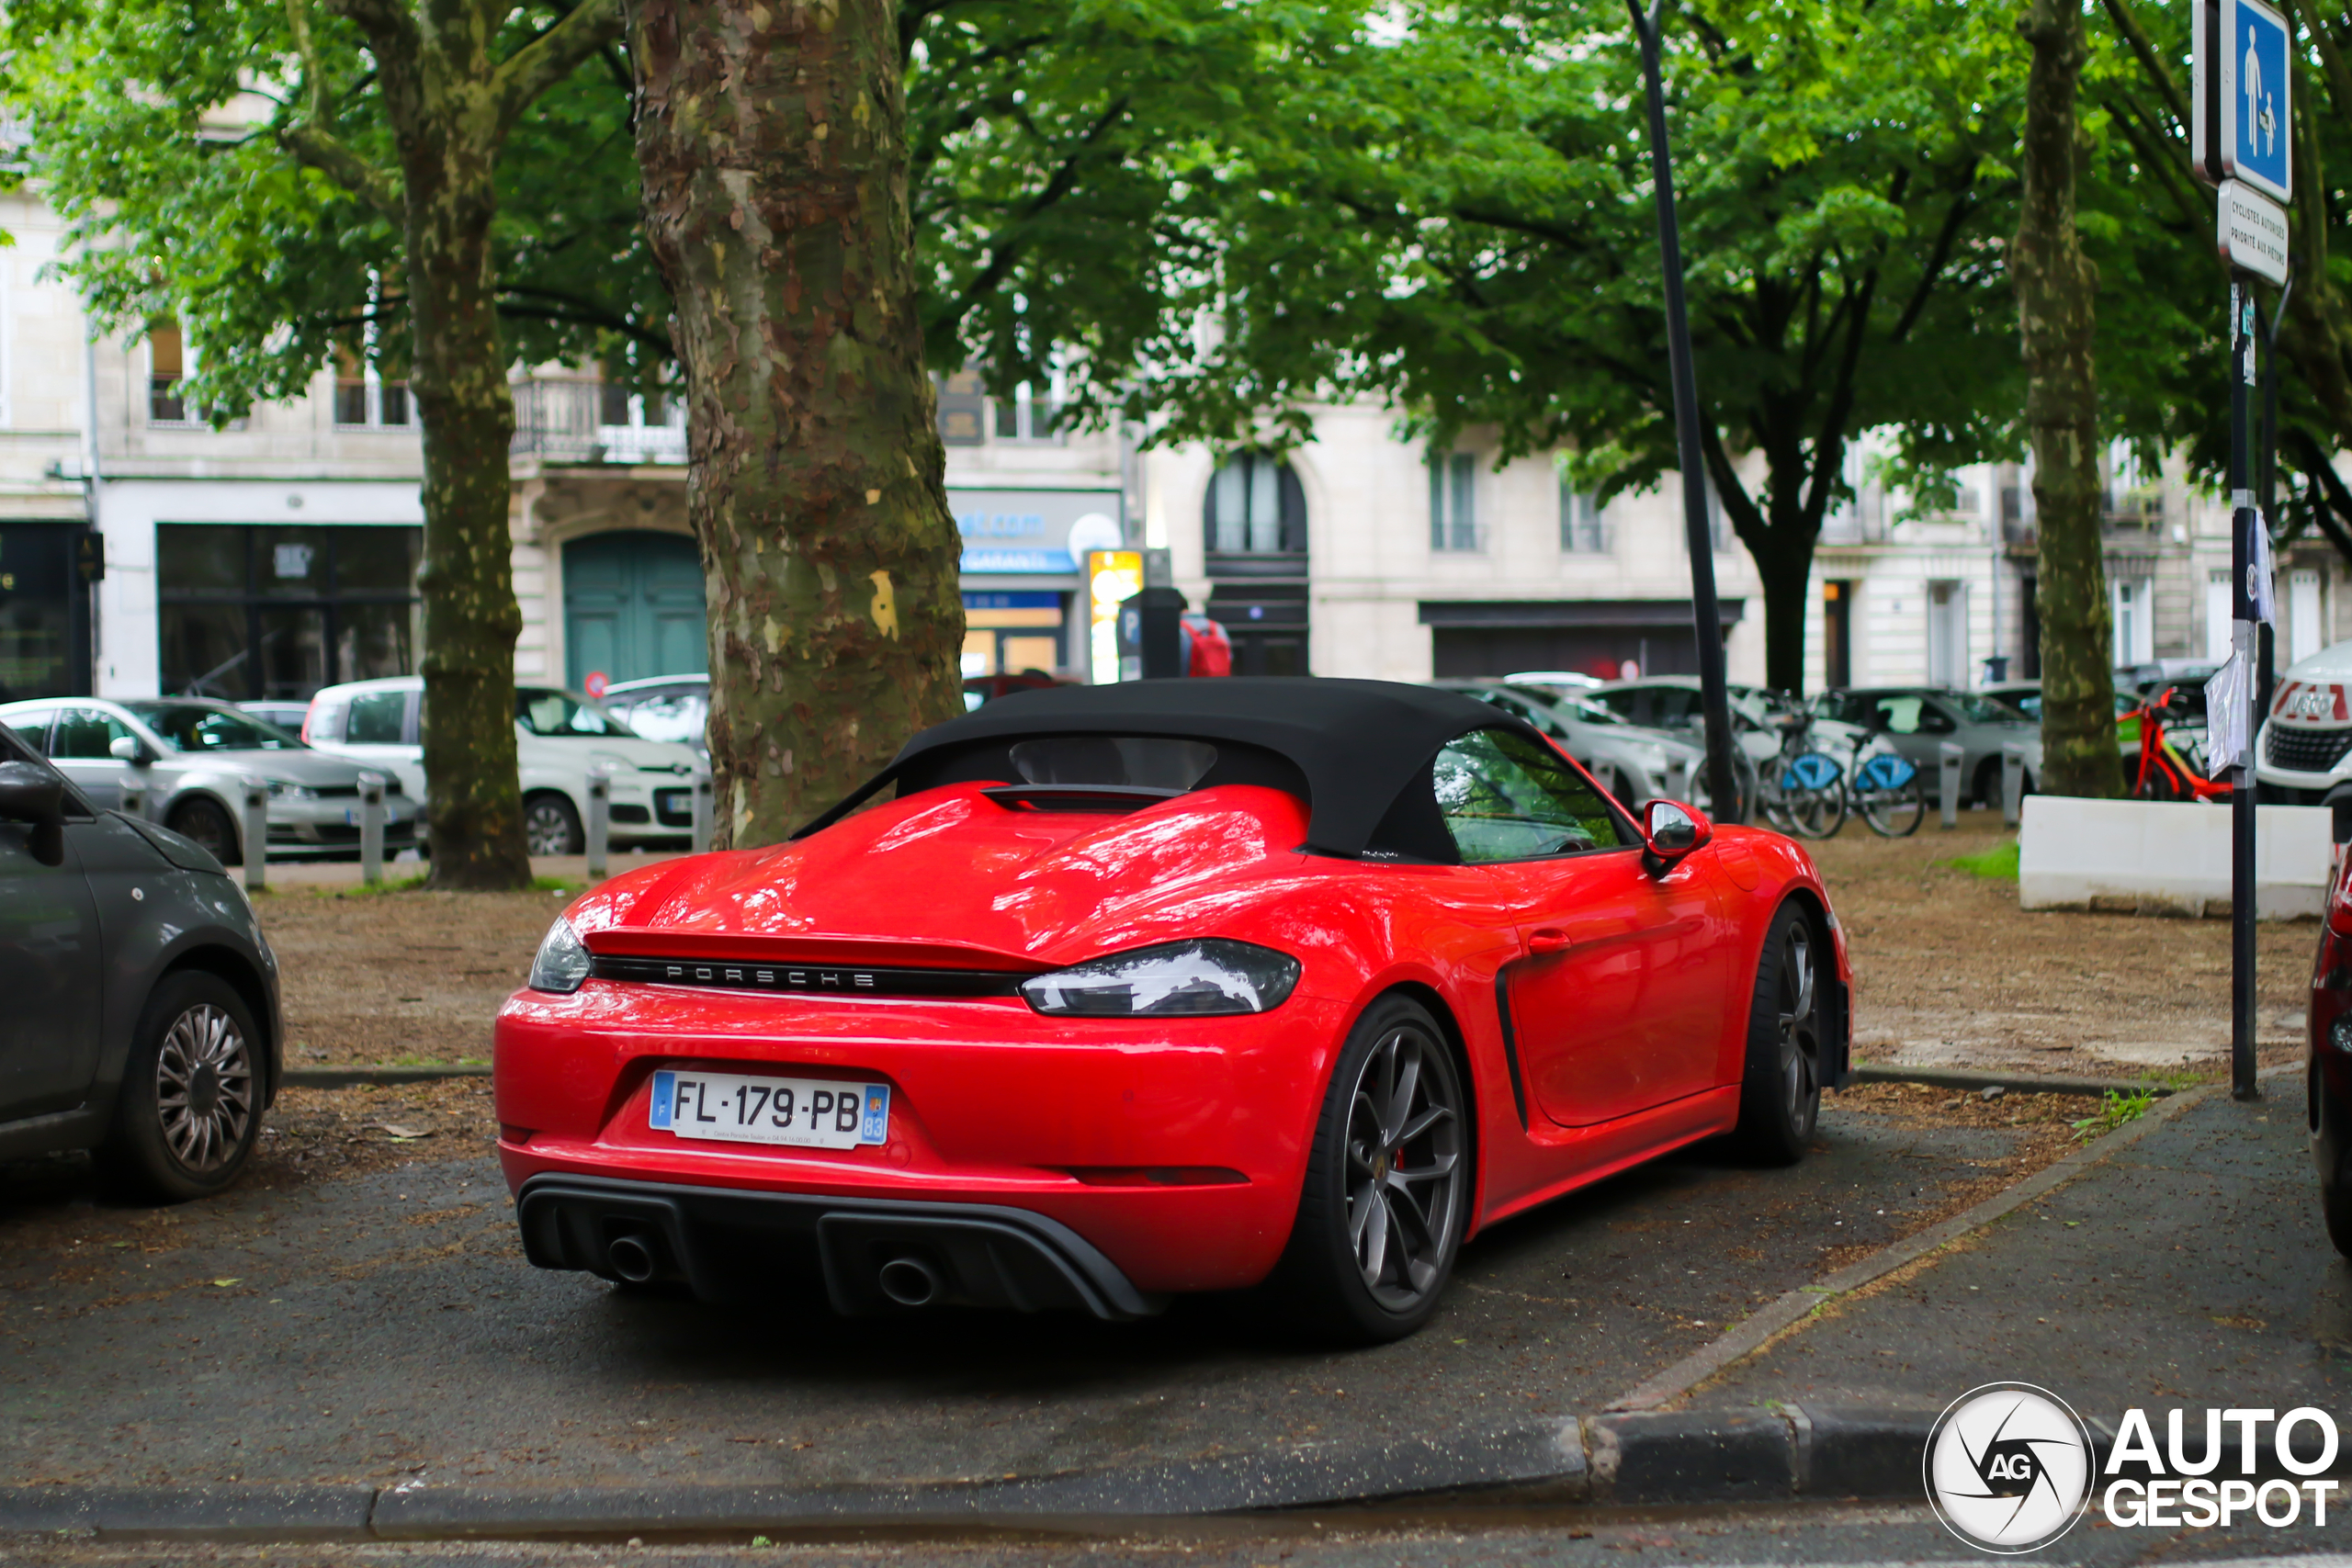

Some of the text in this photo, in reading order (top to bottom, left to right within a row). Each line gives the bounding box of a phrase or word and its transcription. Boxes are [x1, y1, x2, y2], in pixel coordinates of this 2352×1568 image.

[2232, 201, 2284, 241] CYCLISTES AUTORISÉS
[2231, 226, 2284, 266] PRIORITÉ AUX PIÉTONS
[1125, 611, 1139, 639] P
[667, 966, 873, 987] PORSCHE
[659, 1105, 666, 1117] F
[674, 1081, 860, 1133] FL-179-PB
[730, 1132, 749, 1140] Porsche
[864, 1117, 883, 1136] 83
